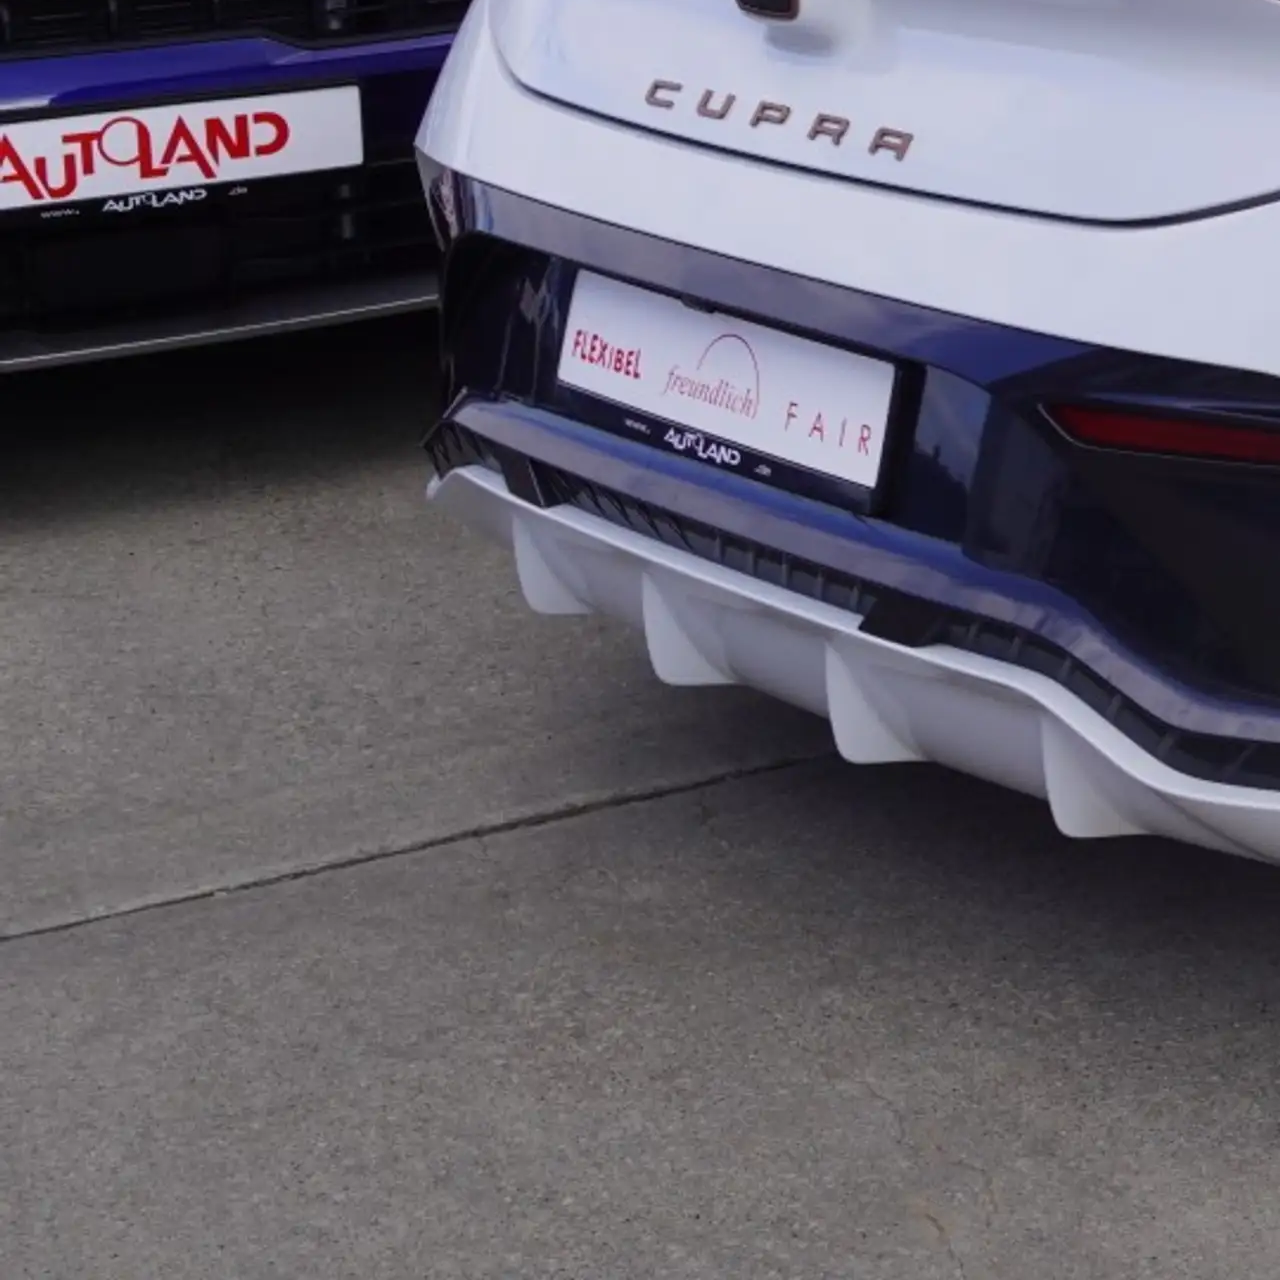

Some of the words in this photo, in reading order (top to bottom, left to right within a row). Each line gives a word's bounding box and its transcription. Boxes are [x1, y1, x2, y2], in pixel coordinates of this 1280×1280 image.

[645, 79, 914, 162] CUPRA
[0, 111, 290, 200] AUTOLAND
[571, 329, 642, 379] FLEXIBEL
[661, 364, 757, 419] freundlich
